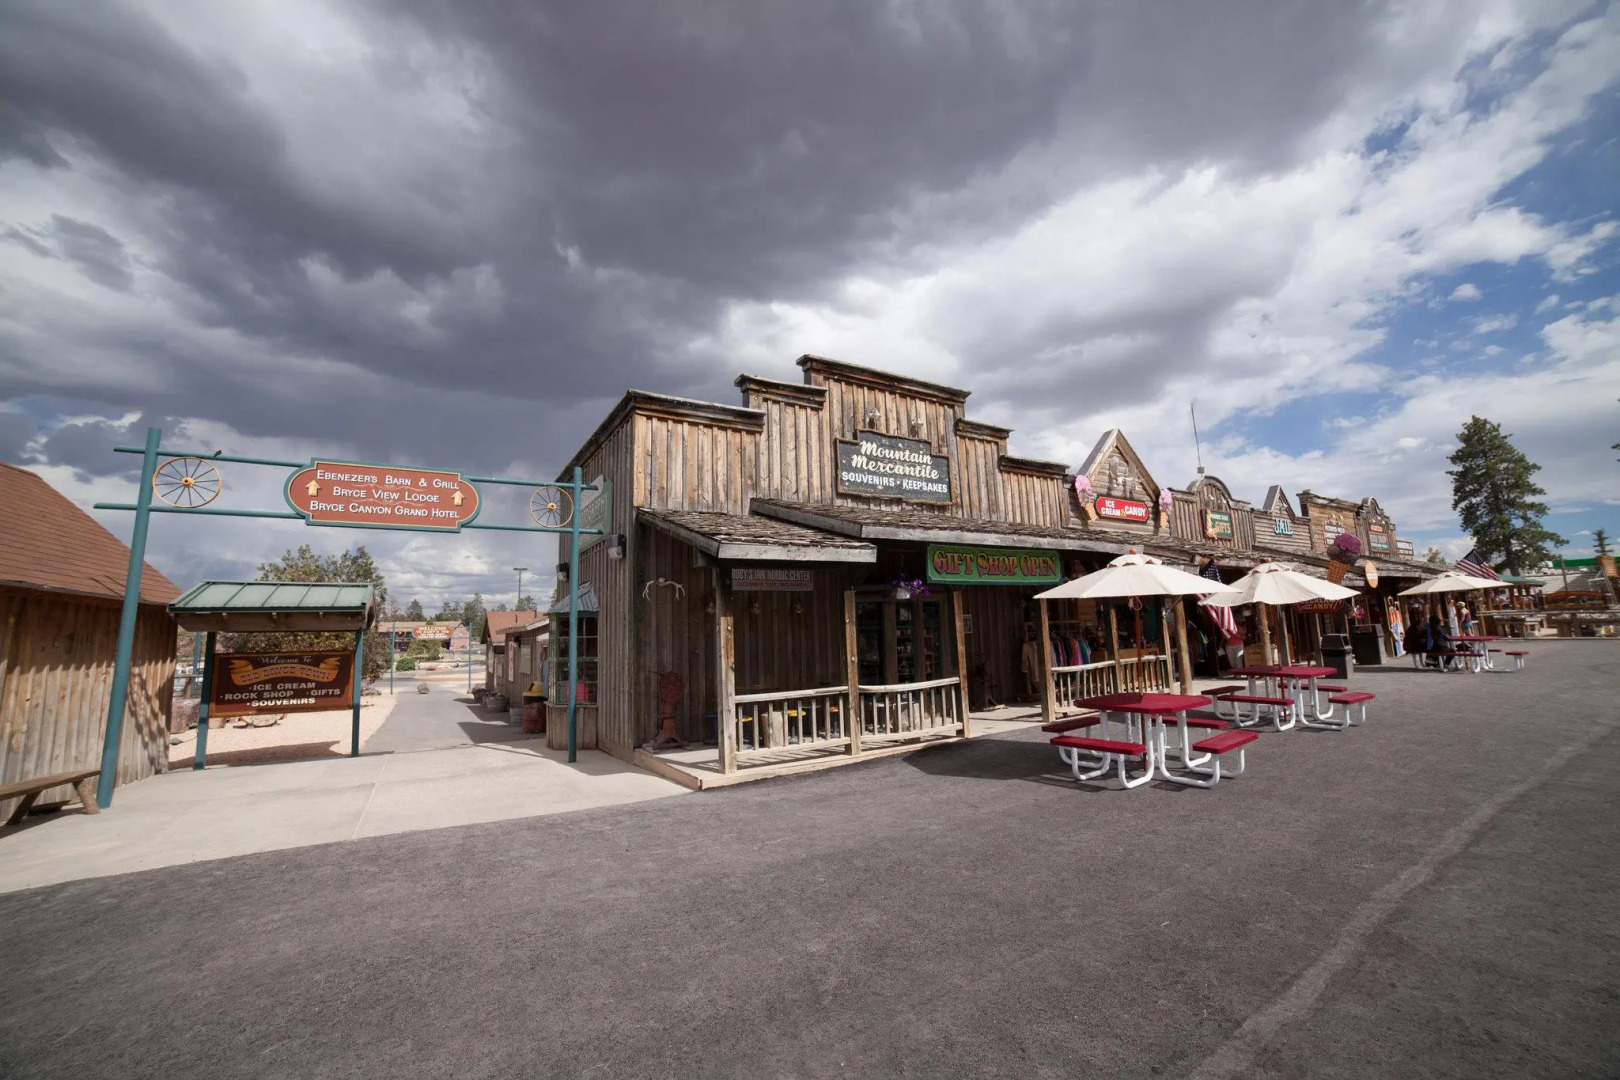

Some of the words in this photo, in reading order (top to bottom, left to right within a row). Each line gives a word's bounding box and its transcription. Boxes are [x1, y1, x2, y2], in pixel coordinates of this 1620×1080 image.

[860, 440, 933, 465] Mountain
[851, 454, 940, 479] Mercantile
[317, 470, 378, 484] EBENEZER'S
[385, 475, 411, 486] BARN
[419, 478, 428, 488] &
[433, 479, 460, 490] GRILL
[842, 472, 895, 487] SOUVENIRS
[902, 479, 948, 493] KEEPSAKES
[333, 487, 367, 498] BRYCE
[372, 489, 400, 500] VIEW
[405, 491, 440, 503] LODGE
[310, 501, 345, 512] BRYCE
[349, 503, 391, 515] CANYON
[395, 506, 428, 517] GRAND
[432, 508, 460, 519] HOTEL
[1101, 507, 1120, 516] CREAM
[1124, 505, 1146, 517] CANDY
[1105, 500, 1115, 508] ICE
[1274, 518, 1294, 535] JAIL
[933, 549, 974, 575] GIFT
[977, 553, 1018, 577] SHOP
[1020, 554, 1057, 577] OPEN
[789, 570, 811, 581] CENTER
[1308, 603, 1334, 611] CANDY
[260, 656, 299, 665] Welcome
[303, 655, 312, 663] To
[300, 666, 330, 680] TOWN
[253, 683, 272, 691] ICE
[277, 682, 316, 690] CREAM
[224, 692, 258, 700] ROCK
[263, 690, 294, 698] SHOP
[311, 688, 341, 696] GIFTS
[251, 697, 316, 707] SOUVENIRS
